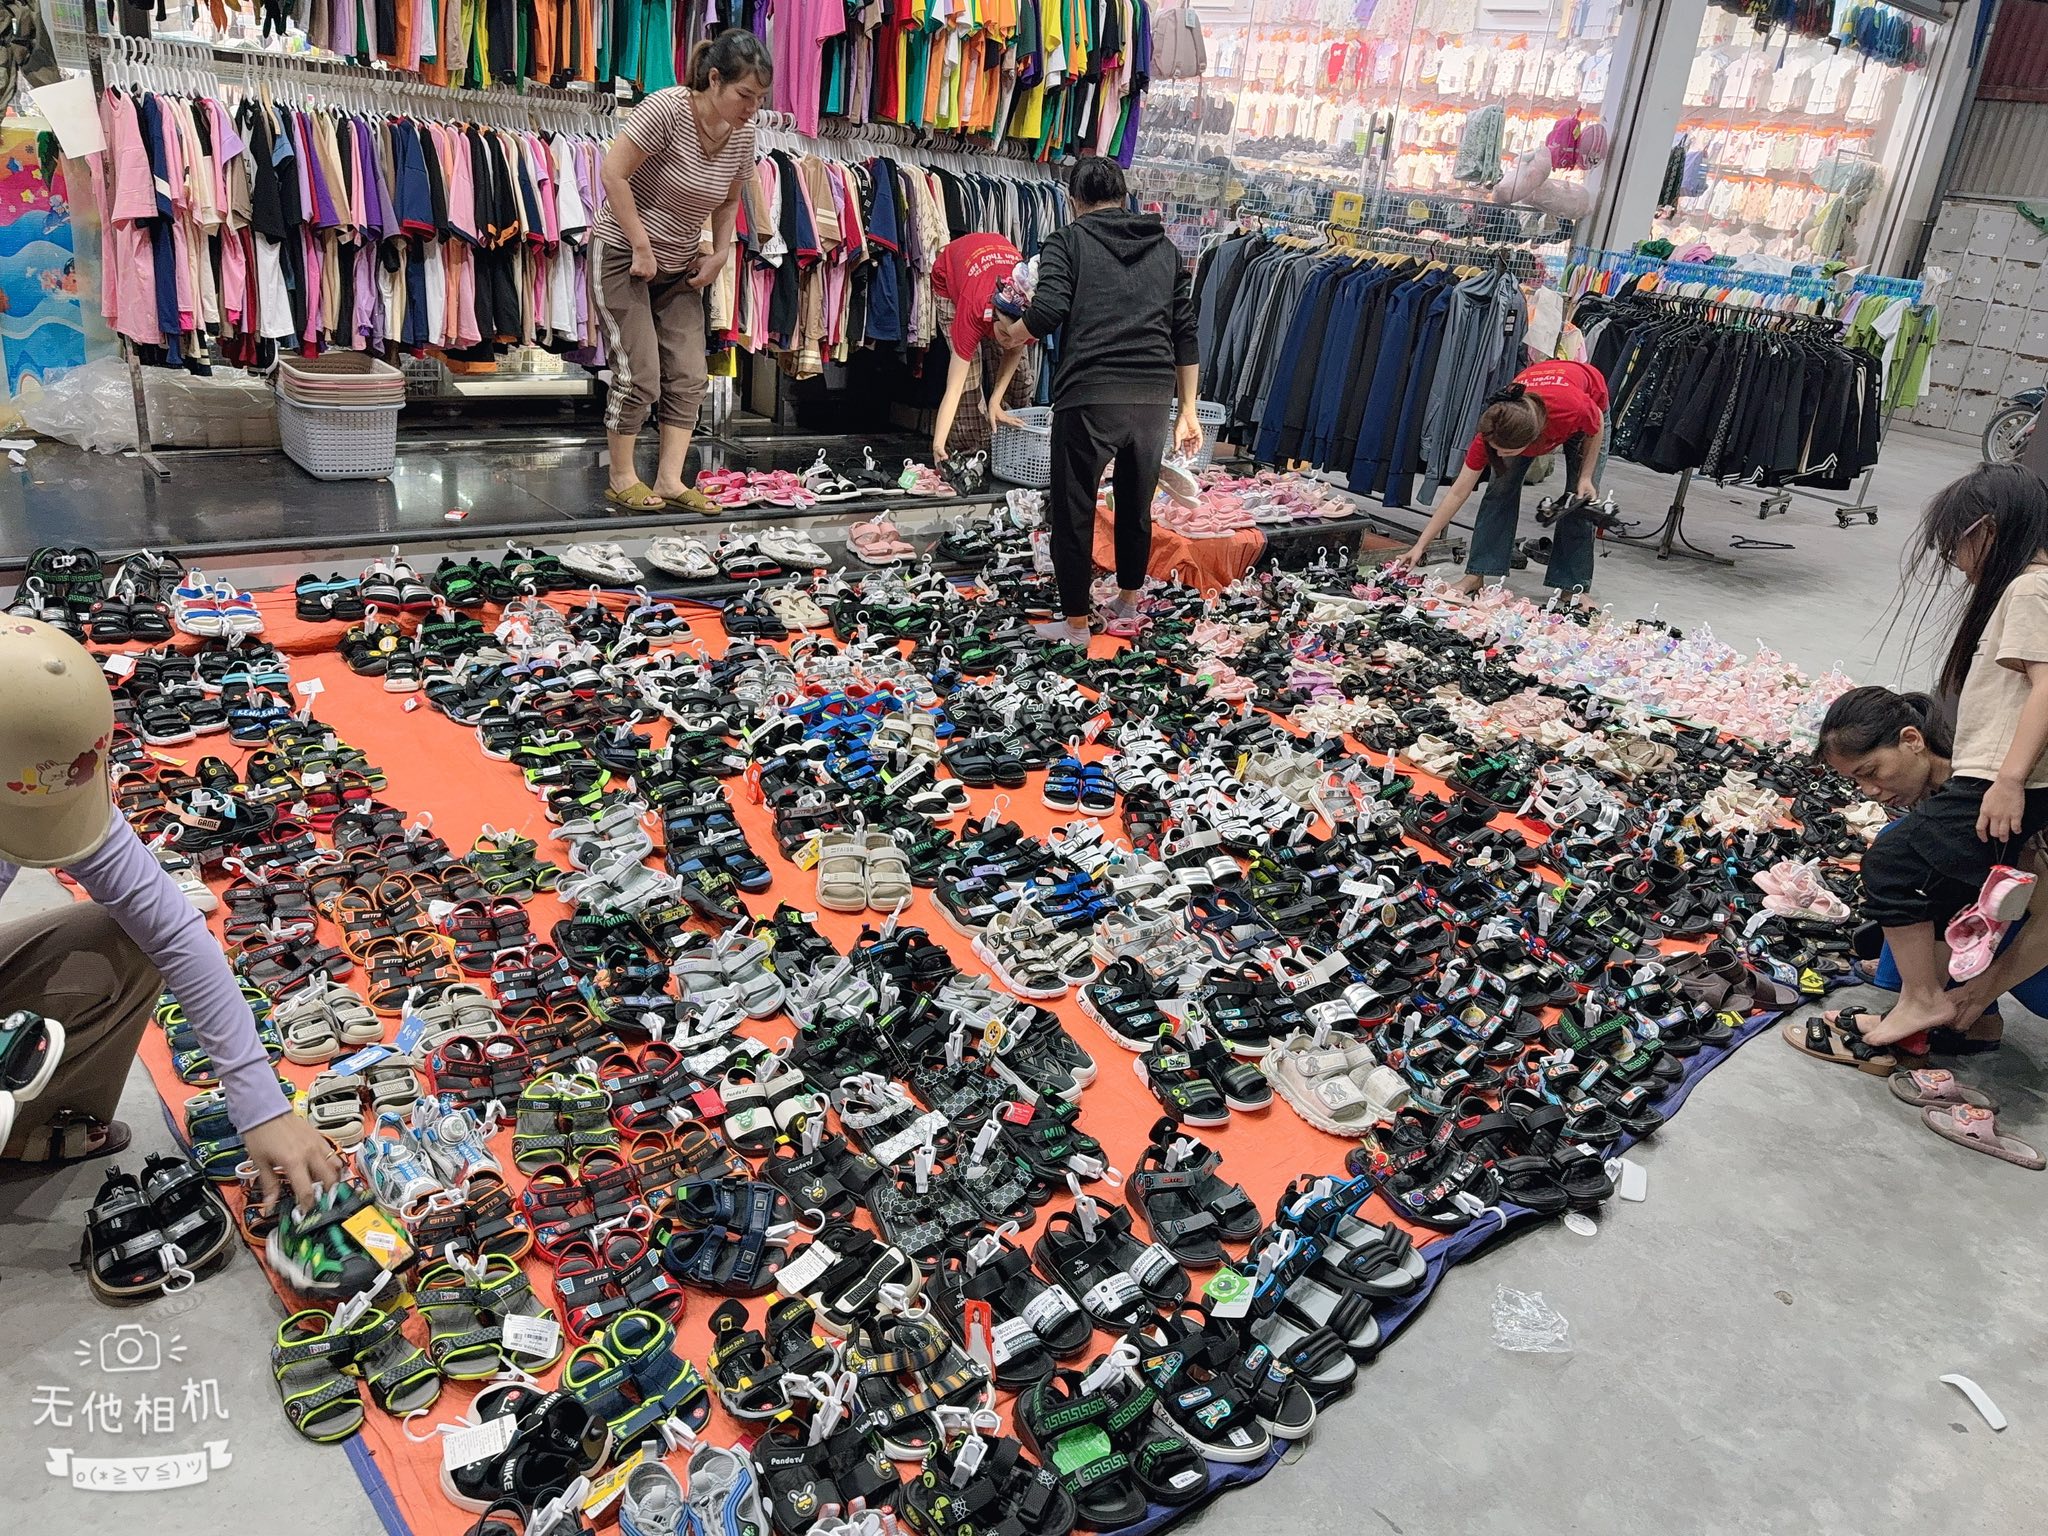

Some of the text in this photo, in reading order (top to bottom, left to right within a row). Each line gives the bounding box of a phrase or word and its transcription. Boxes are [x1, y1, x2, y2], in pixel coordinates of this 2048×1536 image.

[197, 818, 219, 831] GAME
[534, 1391, 561, 1416] MIKE
[770, 1453, 805, 1467] PandaTV
[503, 1457, 517, 1491] MIKE
